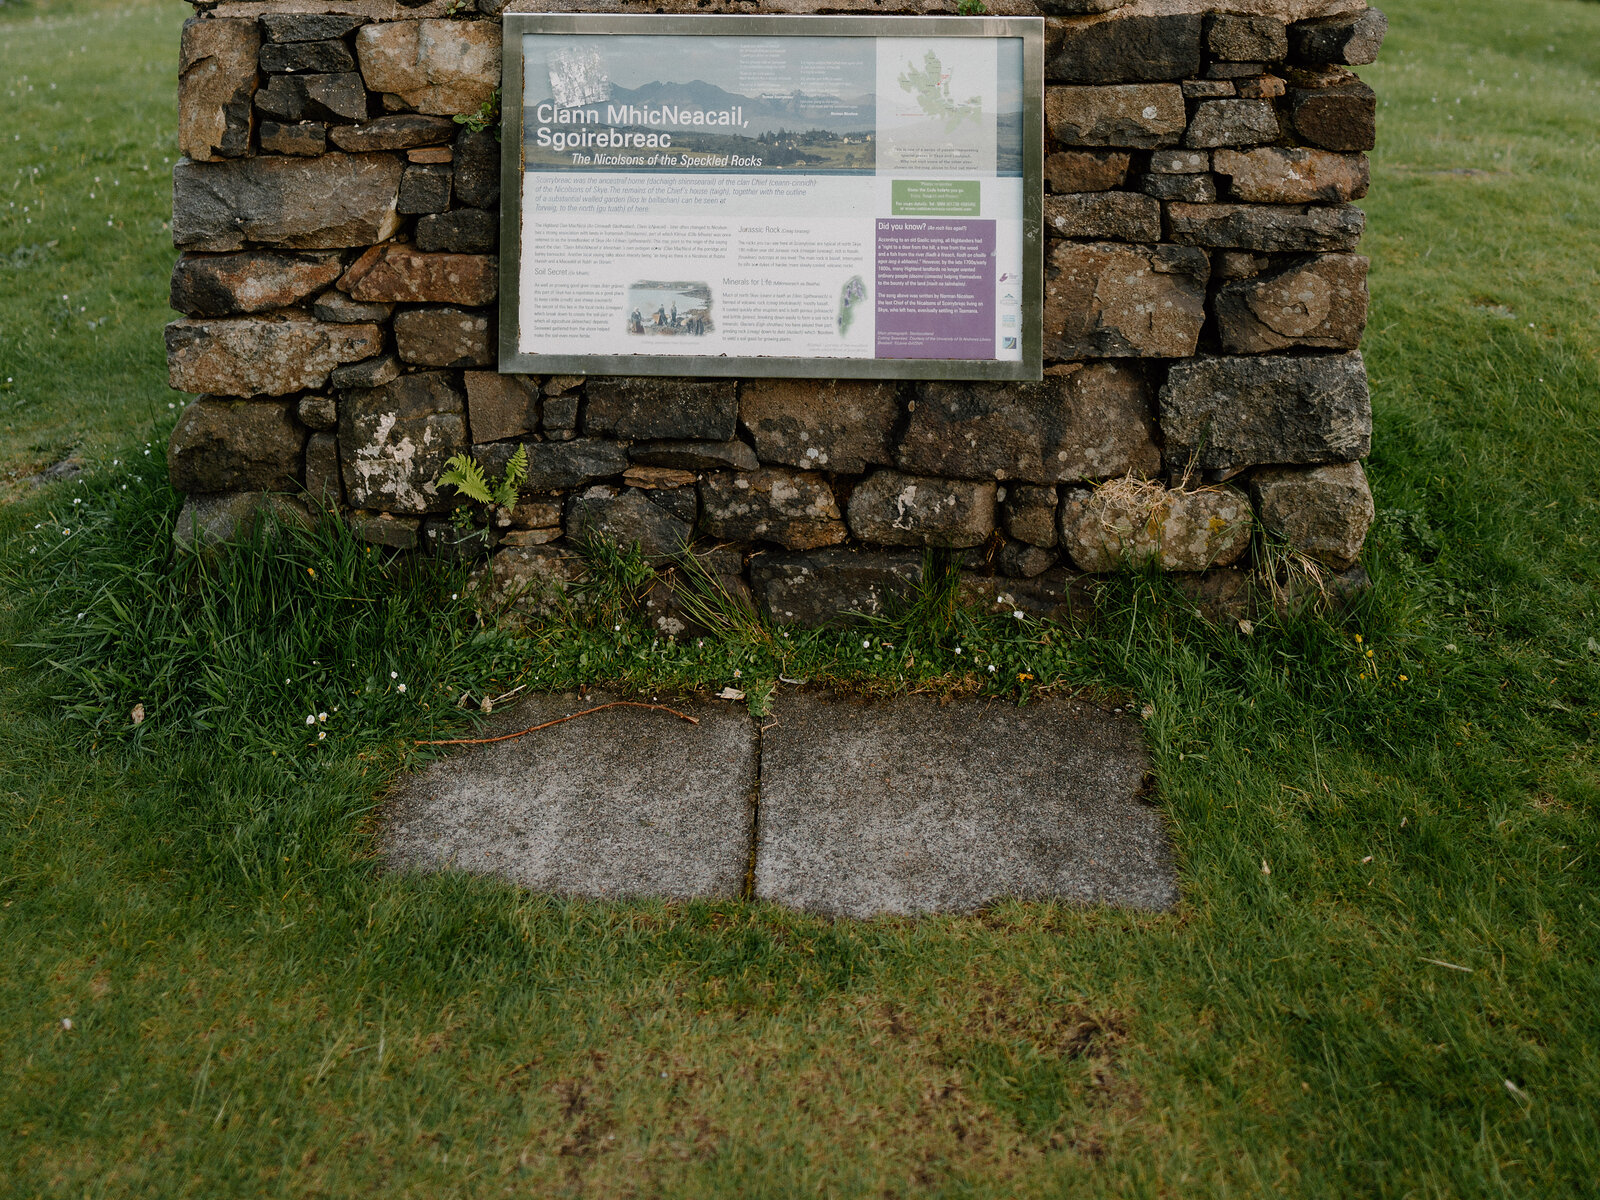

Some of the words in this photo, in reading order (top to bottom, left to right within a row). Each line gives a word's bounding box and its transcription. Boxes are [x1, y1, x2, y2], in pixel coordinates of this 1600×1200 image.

[536, 104, 599, 124] Clann
[607, 105, 749, 128] MhicNeacail,
[536, 127, 671, 152] Sgoirebreac
[572, 153, 591, 165] The
[594, 153, 644, 165] Nicolsons
[647, 154, 660, 166] of
[661, 154, 677, 166] the
[680, 154, 727, 169] Speckled
[731, 155, 762, 167] Rocks
[536, 176, 572, 185] Scorrybreac
[732, 188, 759, 197] together
[604, 196, 626, 205] garden
[891, 224, 903, 232] you
[904, 223, 926, 231] know?
[535, 268, 546, 276] Soil
[548, 268, 568, 276] Secret
[751, 278, 759, 286] for
